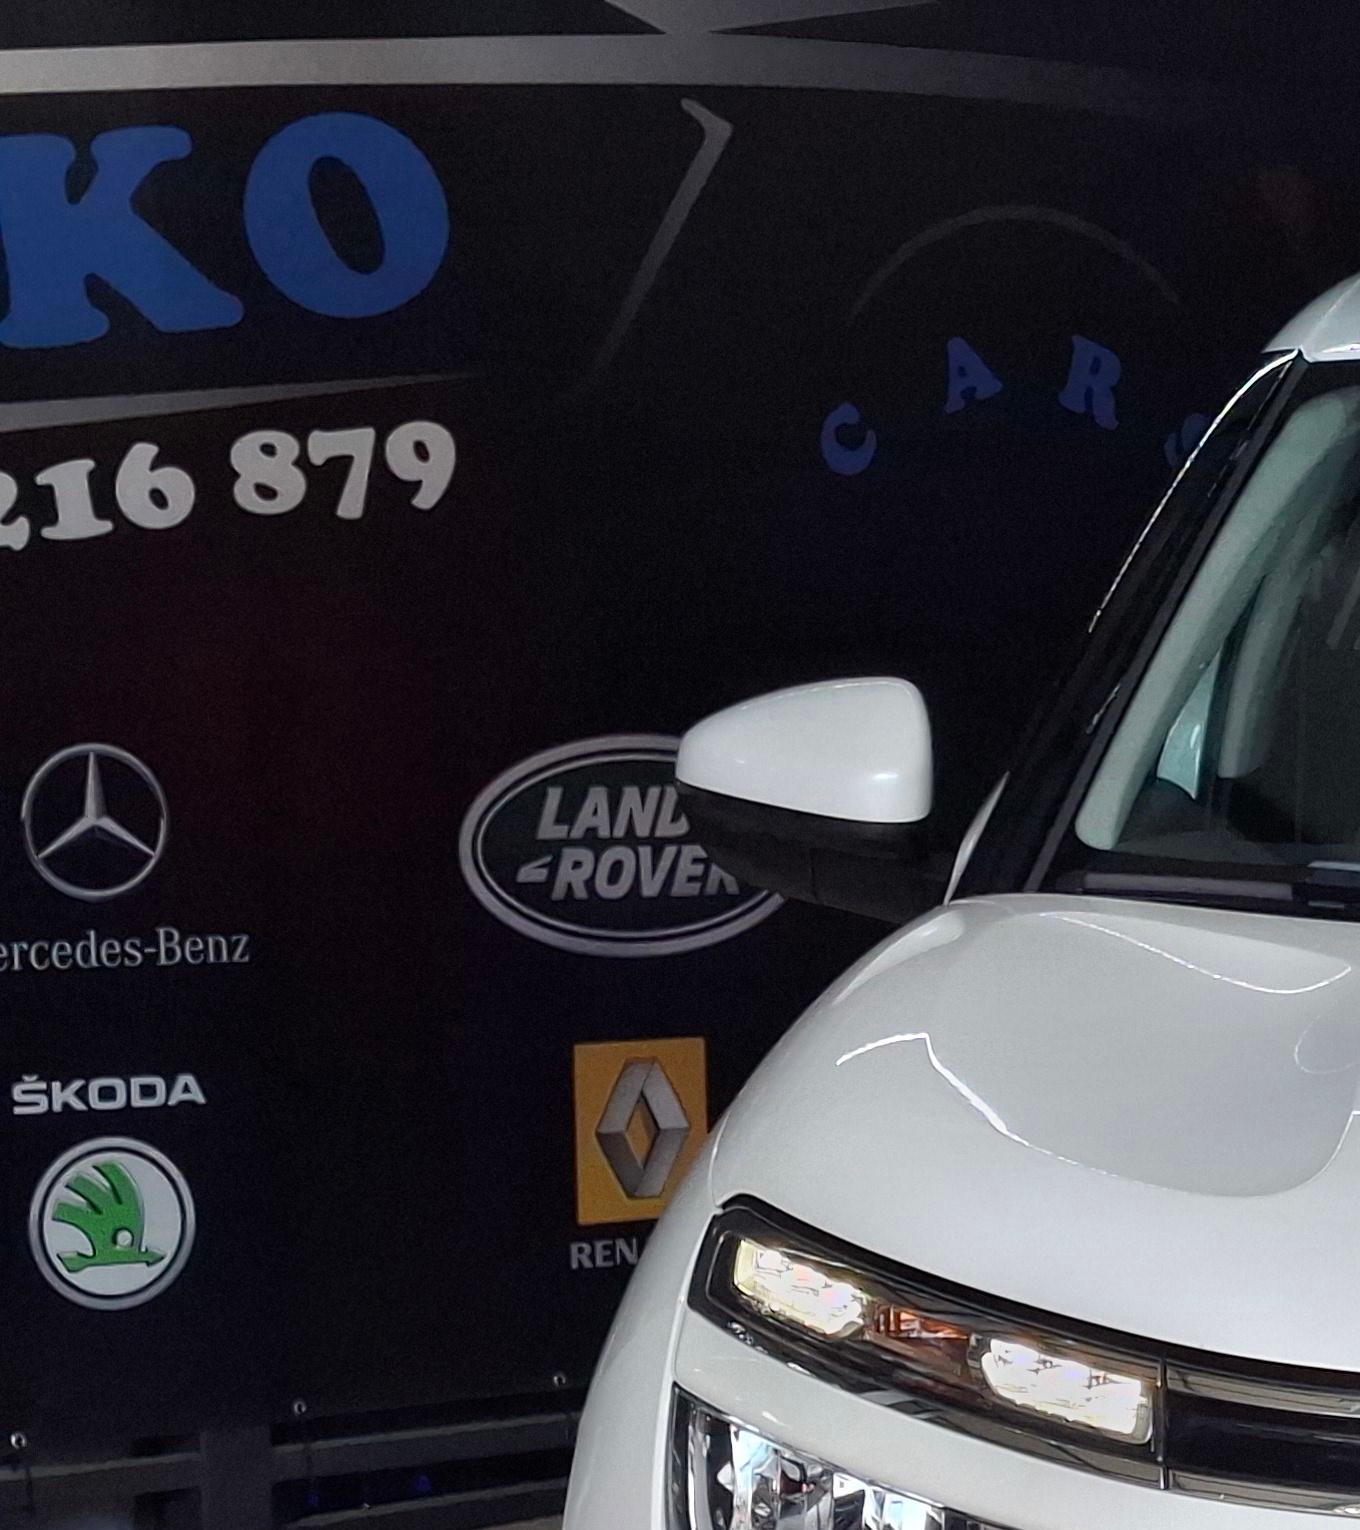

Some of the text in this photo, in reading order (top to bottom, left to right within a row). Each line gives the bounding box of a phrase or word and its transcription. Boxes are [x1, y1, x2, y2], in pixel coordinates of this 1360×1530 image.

[230, 420, 456, 519] 879
[536, 786, 690, 840] LAND
[11, 1073, 206, 1115] ŠKODA
